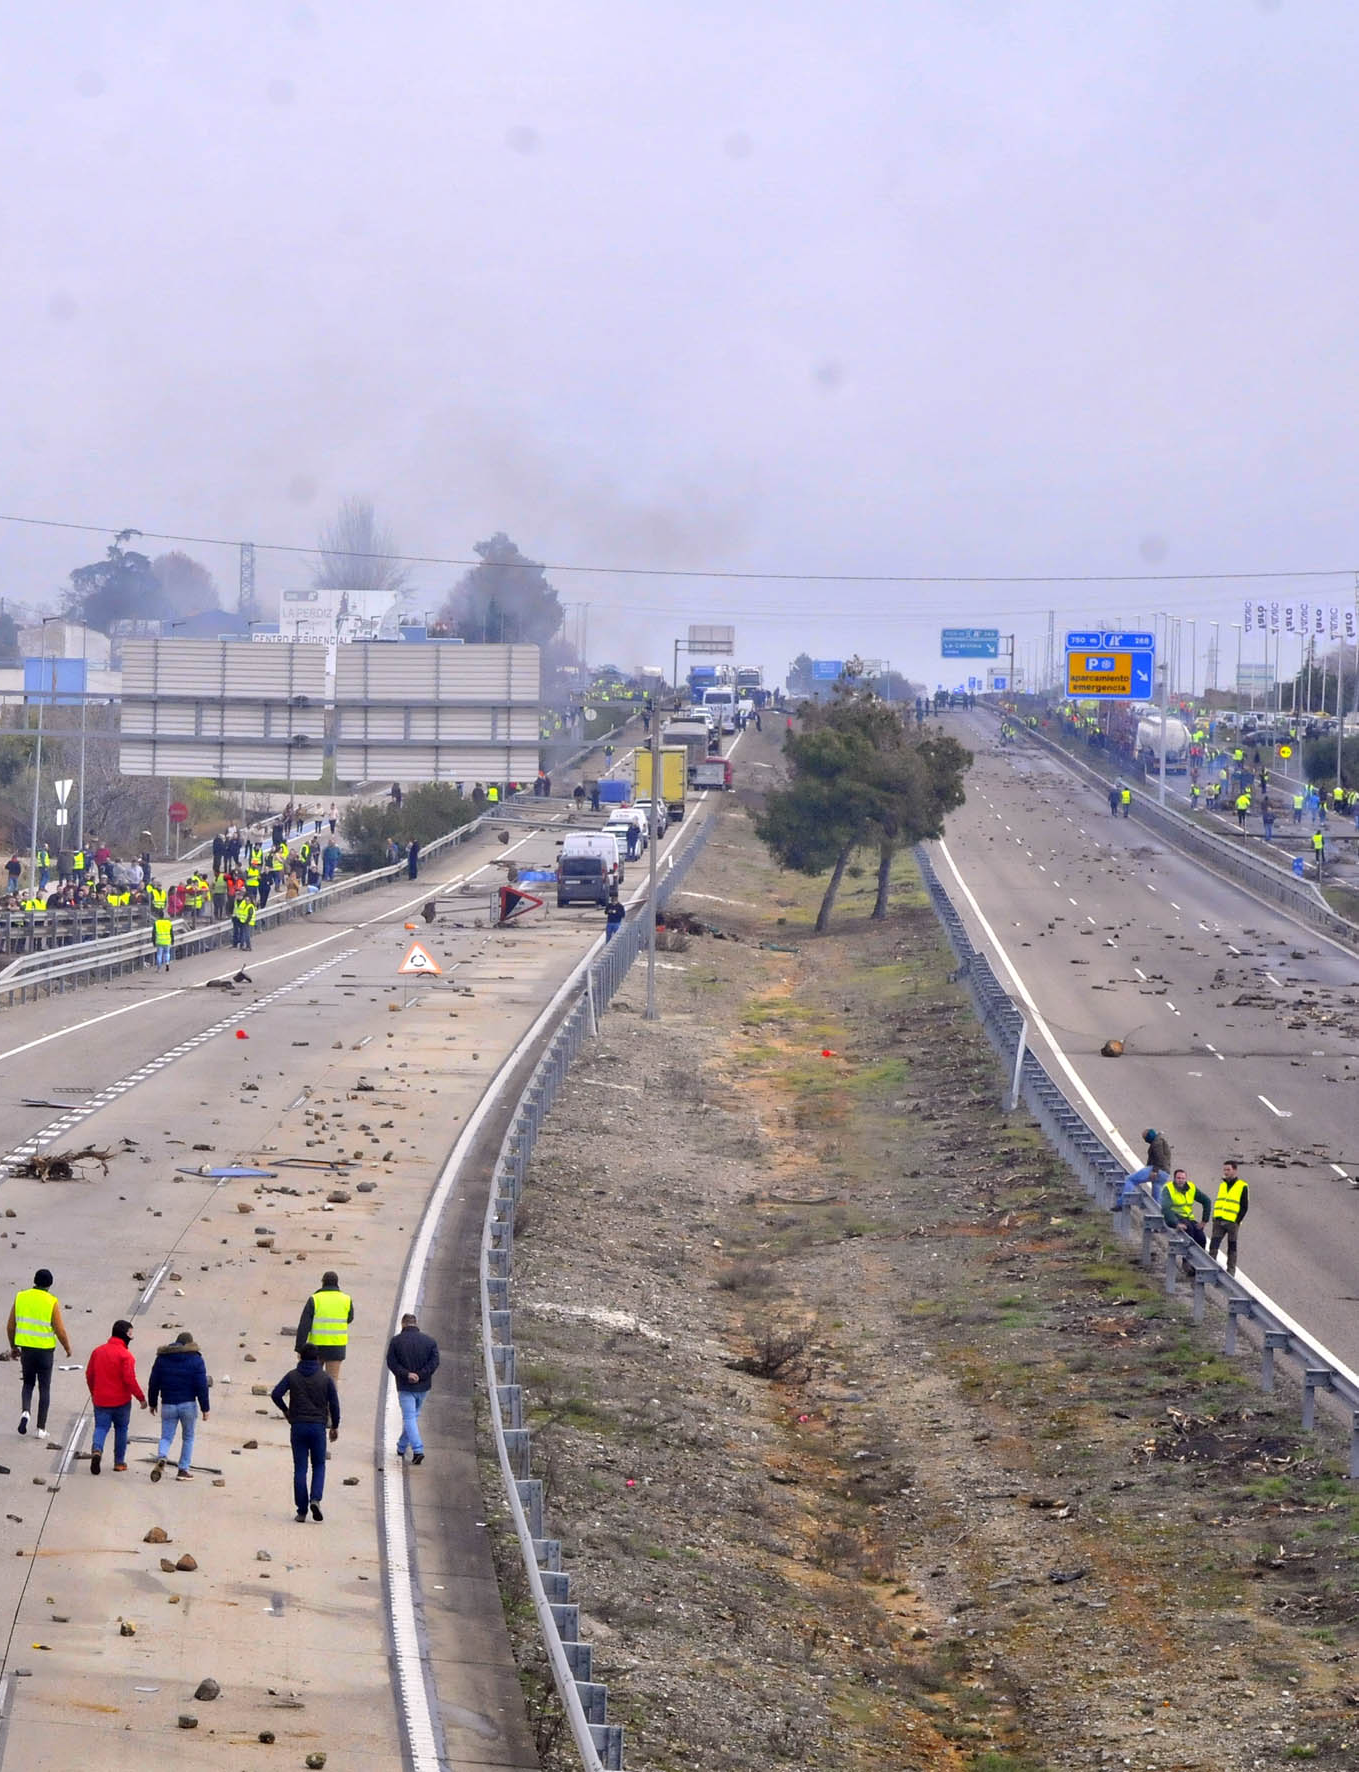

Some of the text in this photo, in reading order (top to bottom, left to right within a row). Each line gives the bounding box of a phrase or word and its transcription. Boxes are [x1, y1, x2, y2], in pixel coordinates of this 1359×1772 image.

[292, 635, 348, 644] RESIDENCIAL
[1088, 658, 1098, 670] P
[1071, 674, 1129, 683] aparcamiento
[1073, 684, 1126, 693] emergencia
